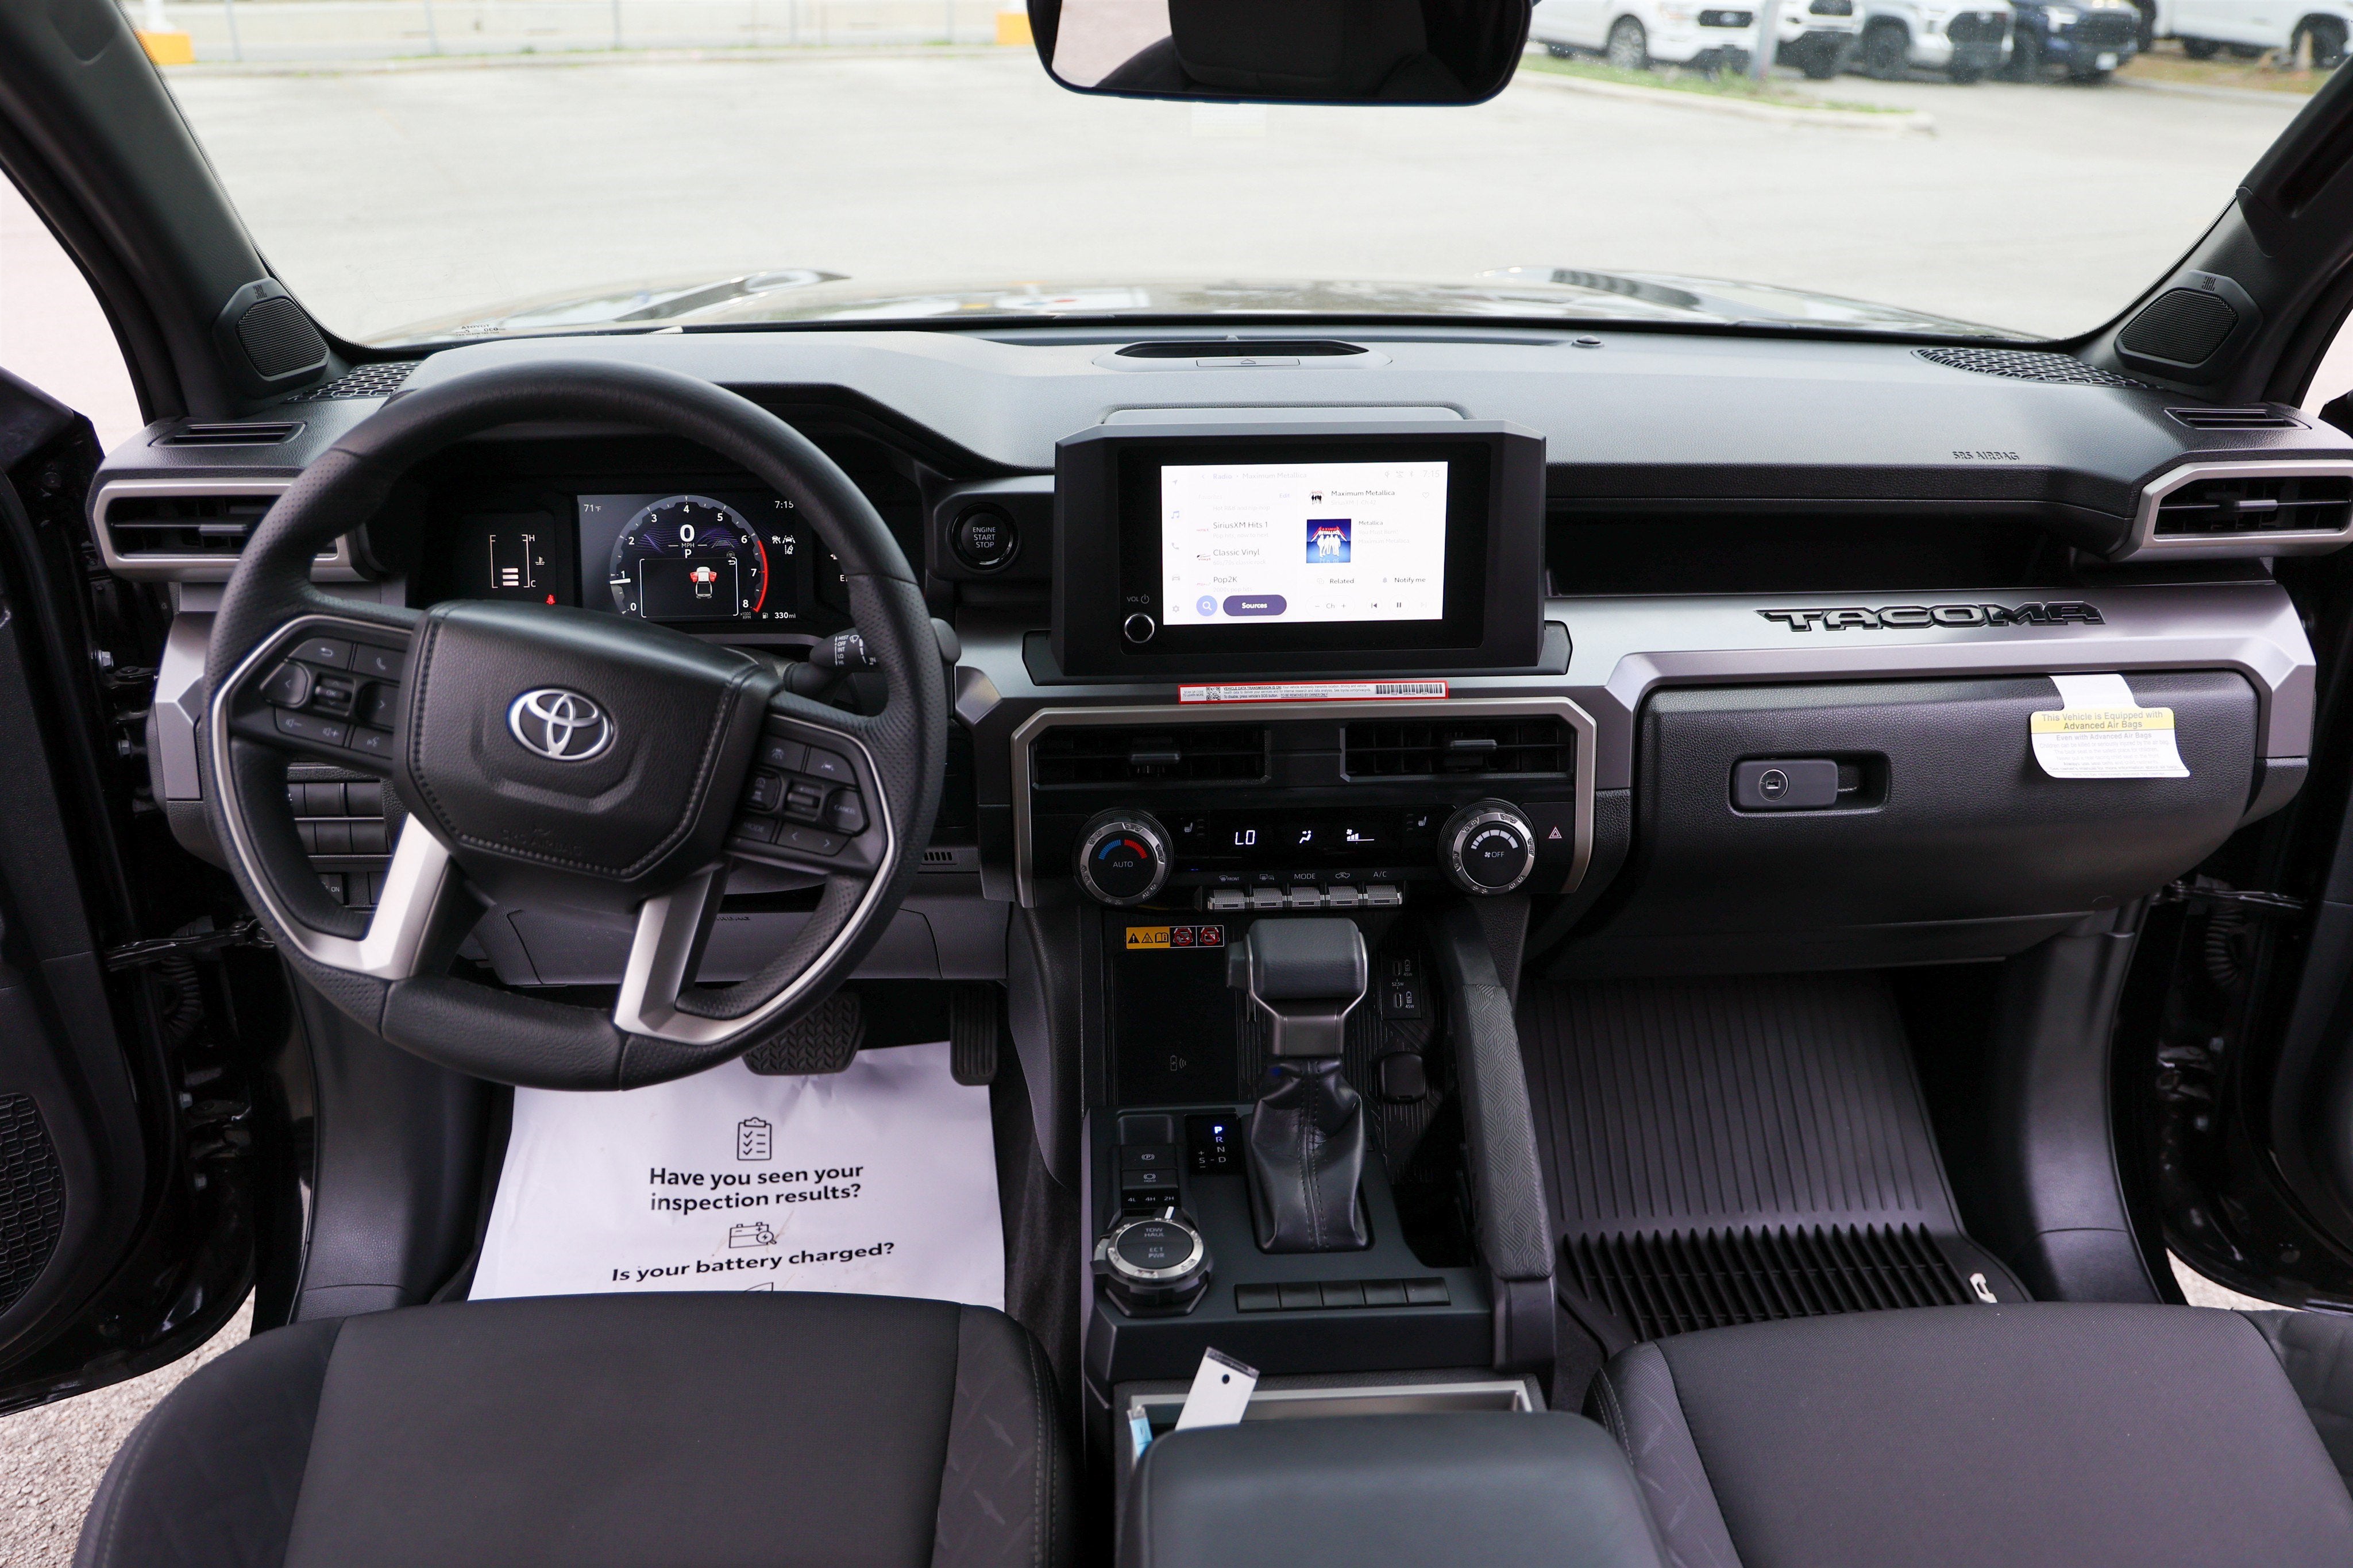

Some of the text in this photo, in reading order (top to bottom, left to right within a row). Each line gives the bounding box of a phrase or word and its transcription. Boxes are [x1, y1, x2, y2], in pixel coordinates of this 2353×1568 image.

[1952, 451, 2020, 460] SRS AIRBAG
[1422, 470, 1440, 478] 7:15
[683, 504, 690, 513] 4
[774, 500, 794, 509] 7:15
[651, 513, 658, 523] 3
[717, 512, 723, 522] 5
[1213, 521, 1246, 529] SiriusXM
[680, 524, 695, 542] 0
[628, 536, 635, 545] 2
[740, 535, 747, 544] 6
[684, 548, 692, 559] P
[1241, 548, 1260, 557] Vinyl
[620, 570, 626, 579] 1
[750, 568, 757, 577] 7
[530, 580, 537, 588] C
[1213, 576, 1238, 584] Pop2K
[1394, 577, 1414, 585] Notify
[630, 602, 637, 611] 0
[742, 599, 749, 608] 8
[1755, 600, 2107, 633] TACOMA
[2042, 710, 2163, 723] This Vehicle is Equipped with
[2063, 720, 2143, 730] Advanced Air Bags
[834, 804, 856, 814] CANCEL
[1235, 829, 1256, 846] LO
[1491, 851, 1505, 859] OFF
[1112, 860, 1134, 868] AUTO
[1373, 870, 1387, 878] A/C
[1214, 1126, 1223, 1134] P
[650, 1166, 864, 1191] Have you seen your
[650, 1183, 861, 1216] inspection results?
[612, 1242, 894, 1283] Is your battery charged?
